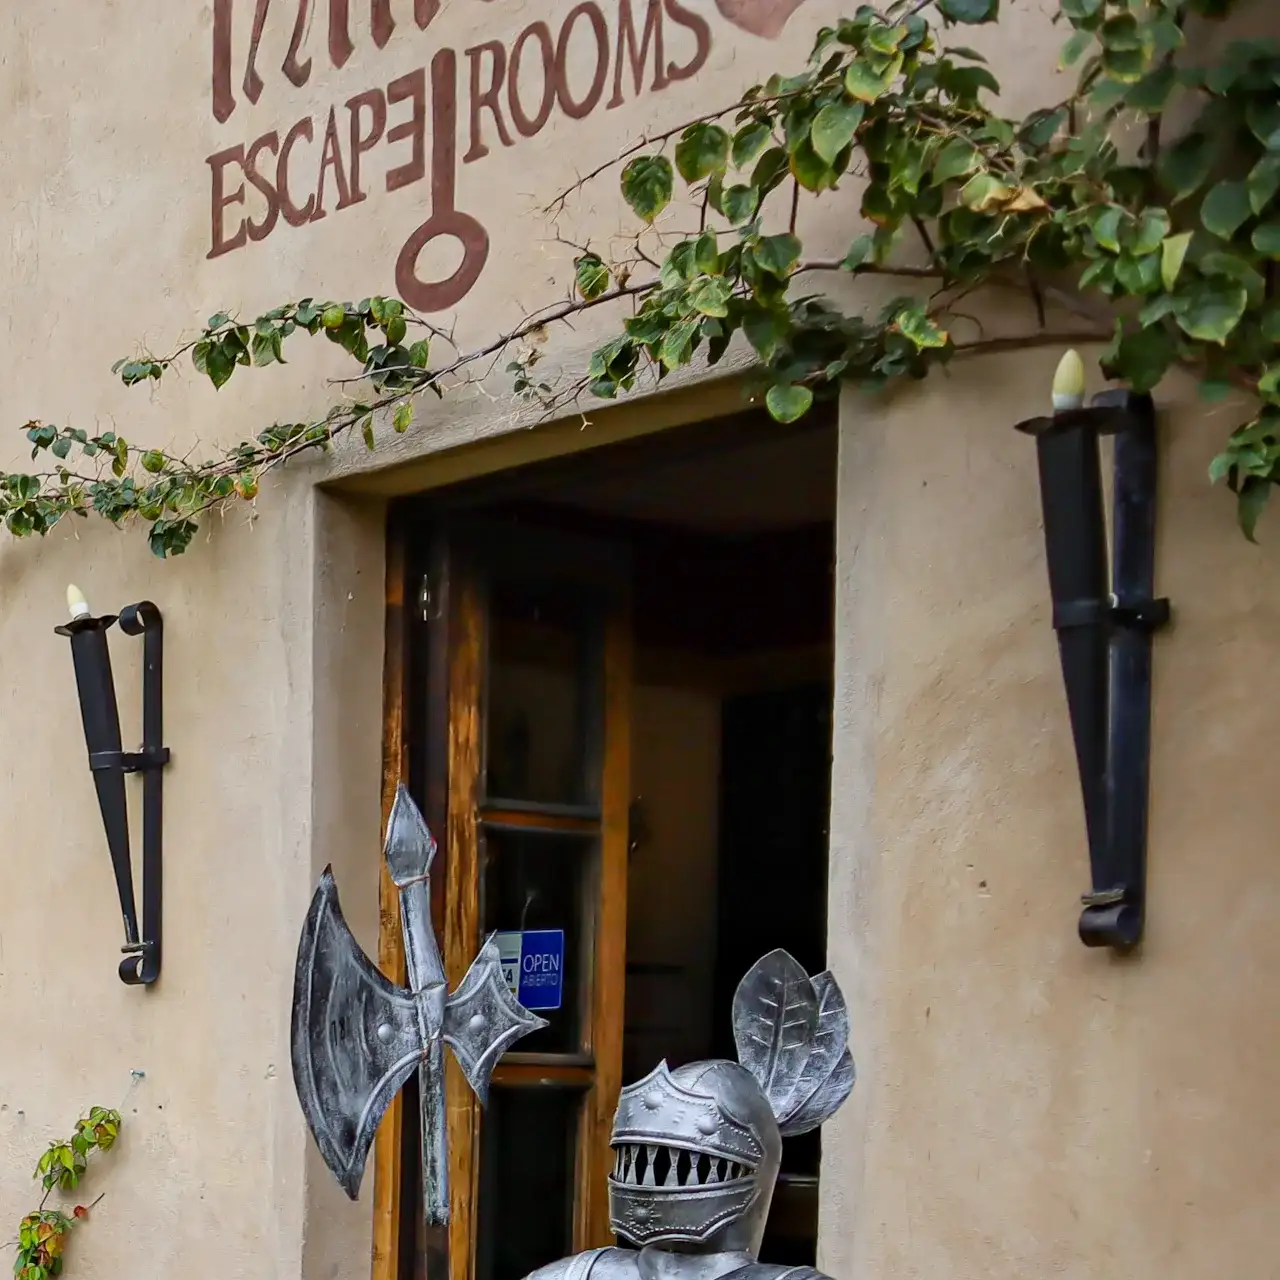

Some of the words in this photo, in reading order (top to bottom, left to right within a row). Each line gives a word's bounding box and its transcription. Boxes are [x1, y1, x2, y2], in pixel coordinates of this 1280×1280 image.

[206, 68, 425, 260] ESCAPE
[463, 0, 713, 163] ROOMS
[523, 953, 559, 973] OPEN
